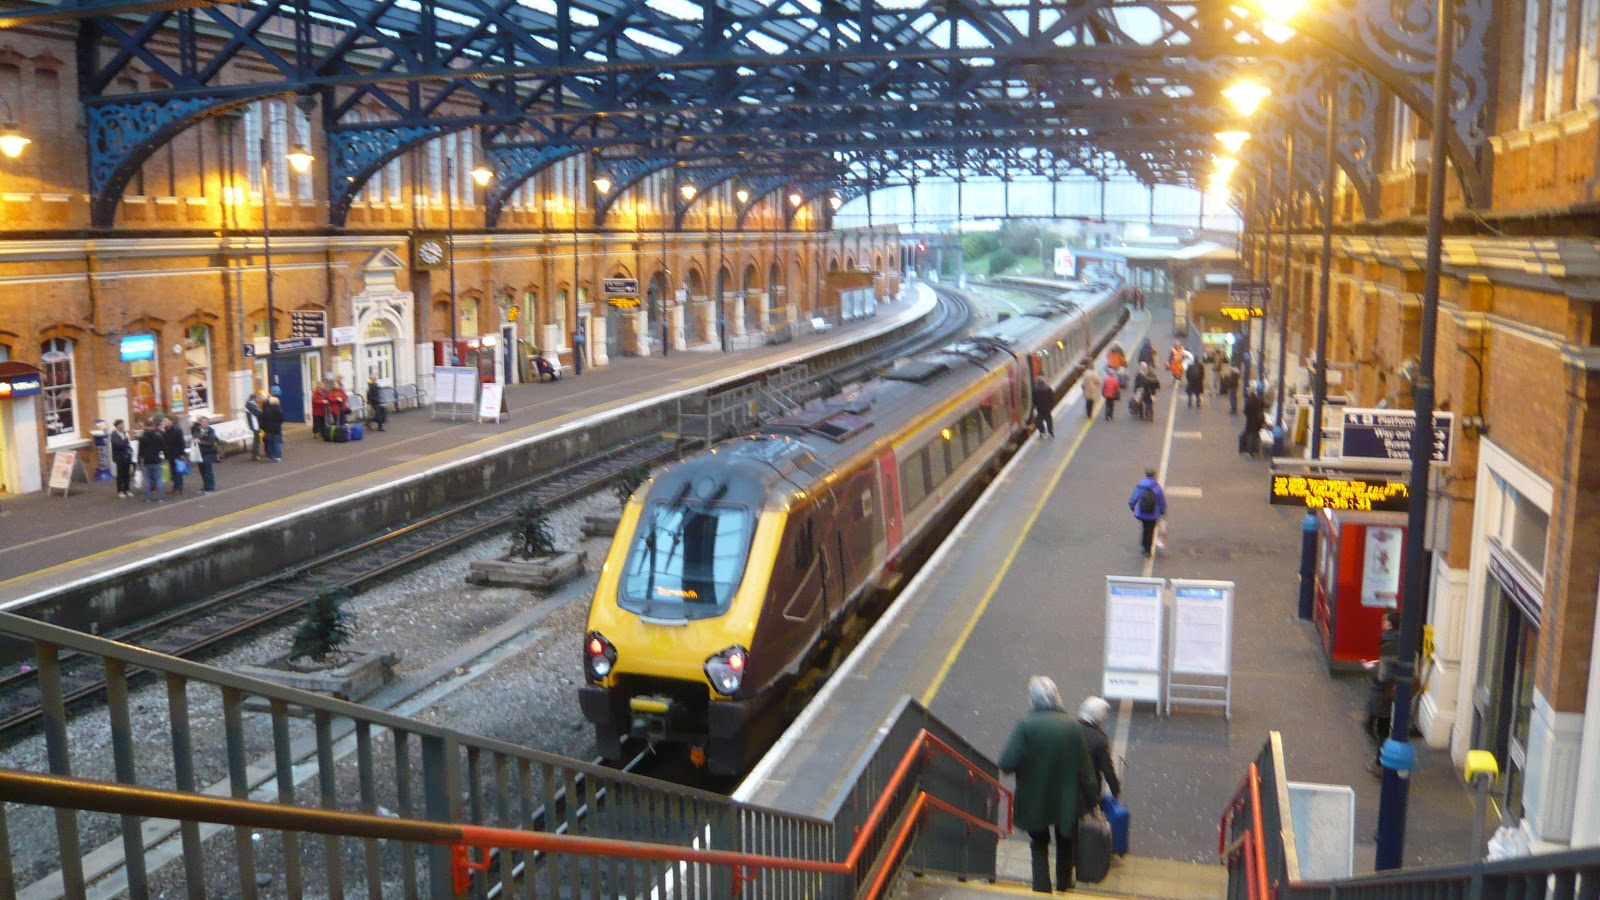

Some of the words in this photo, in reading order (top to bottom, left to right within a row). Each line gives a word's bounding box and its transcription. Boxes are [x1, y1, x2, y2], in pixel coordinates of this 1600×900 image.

[1377, 414, 1415, 427] Platform
[1374, 427, 1394, 440] Way
[1395, 429, 1411, 440] out
